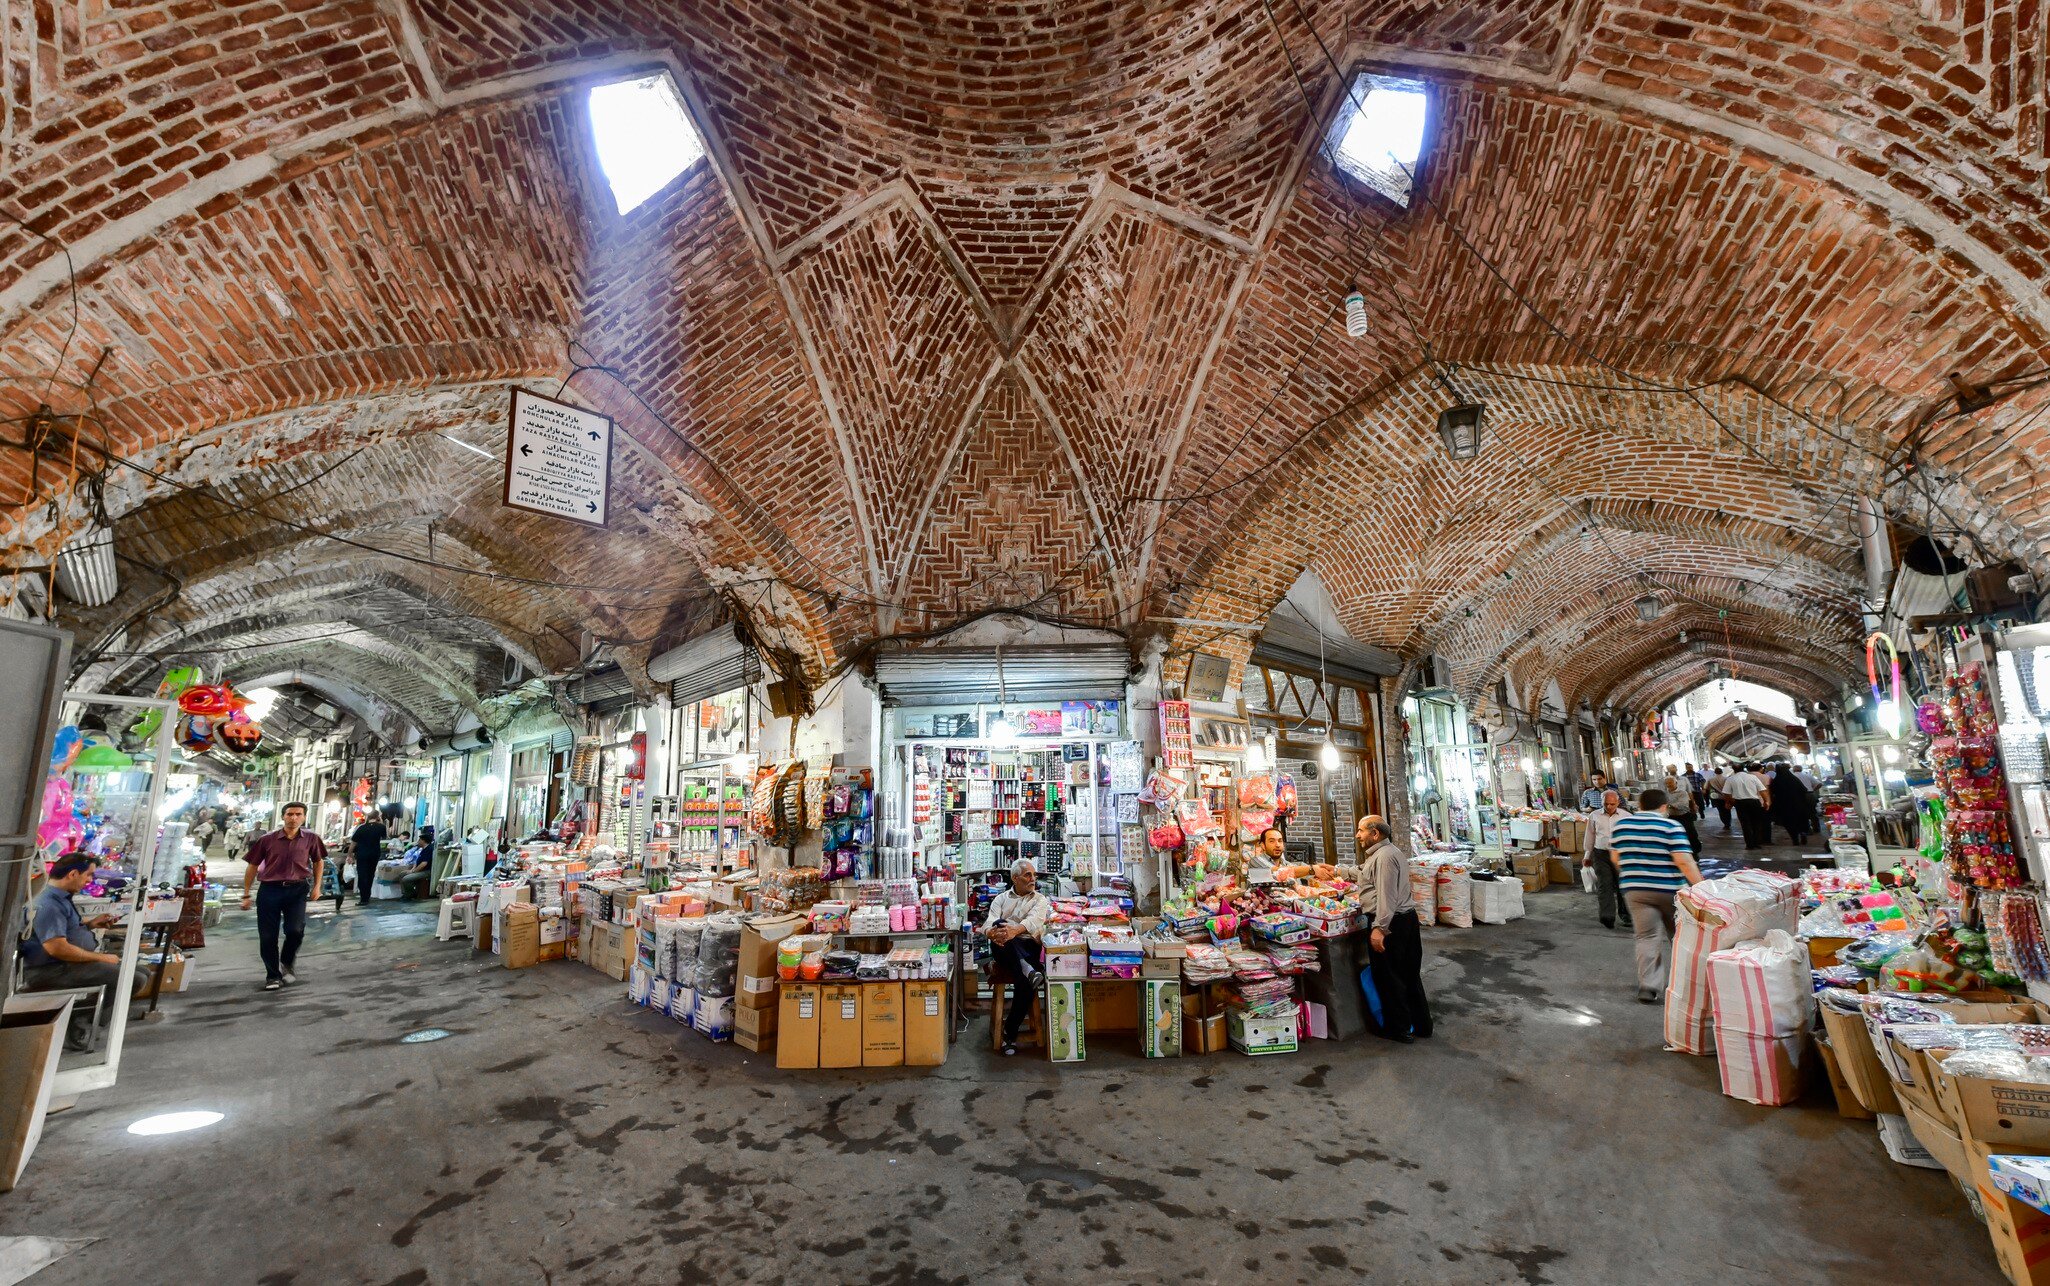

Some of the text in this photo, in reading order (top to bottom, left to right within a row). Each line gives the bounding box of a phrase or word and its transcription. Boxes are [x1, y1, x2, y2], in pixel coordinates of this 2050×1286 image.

[564, 414, 579, 424] بازار
[522, 426, 538, 435] TAZA
[546, 426, 560, 435] بازار
[582, 454, 597, 462] بازار
[567, 466, 580, 474] بازار
[540, 494, 554, 502] بازار
